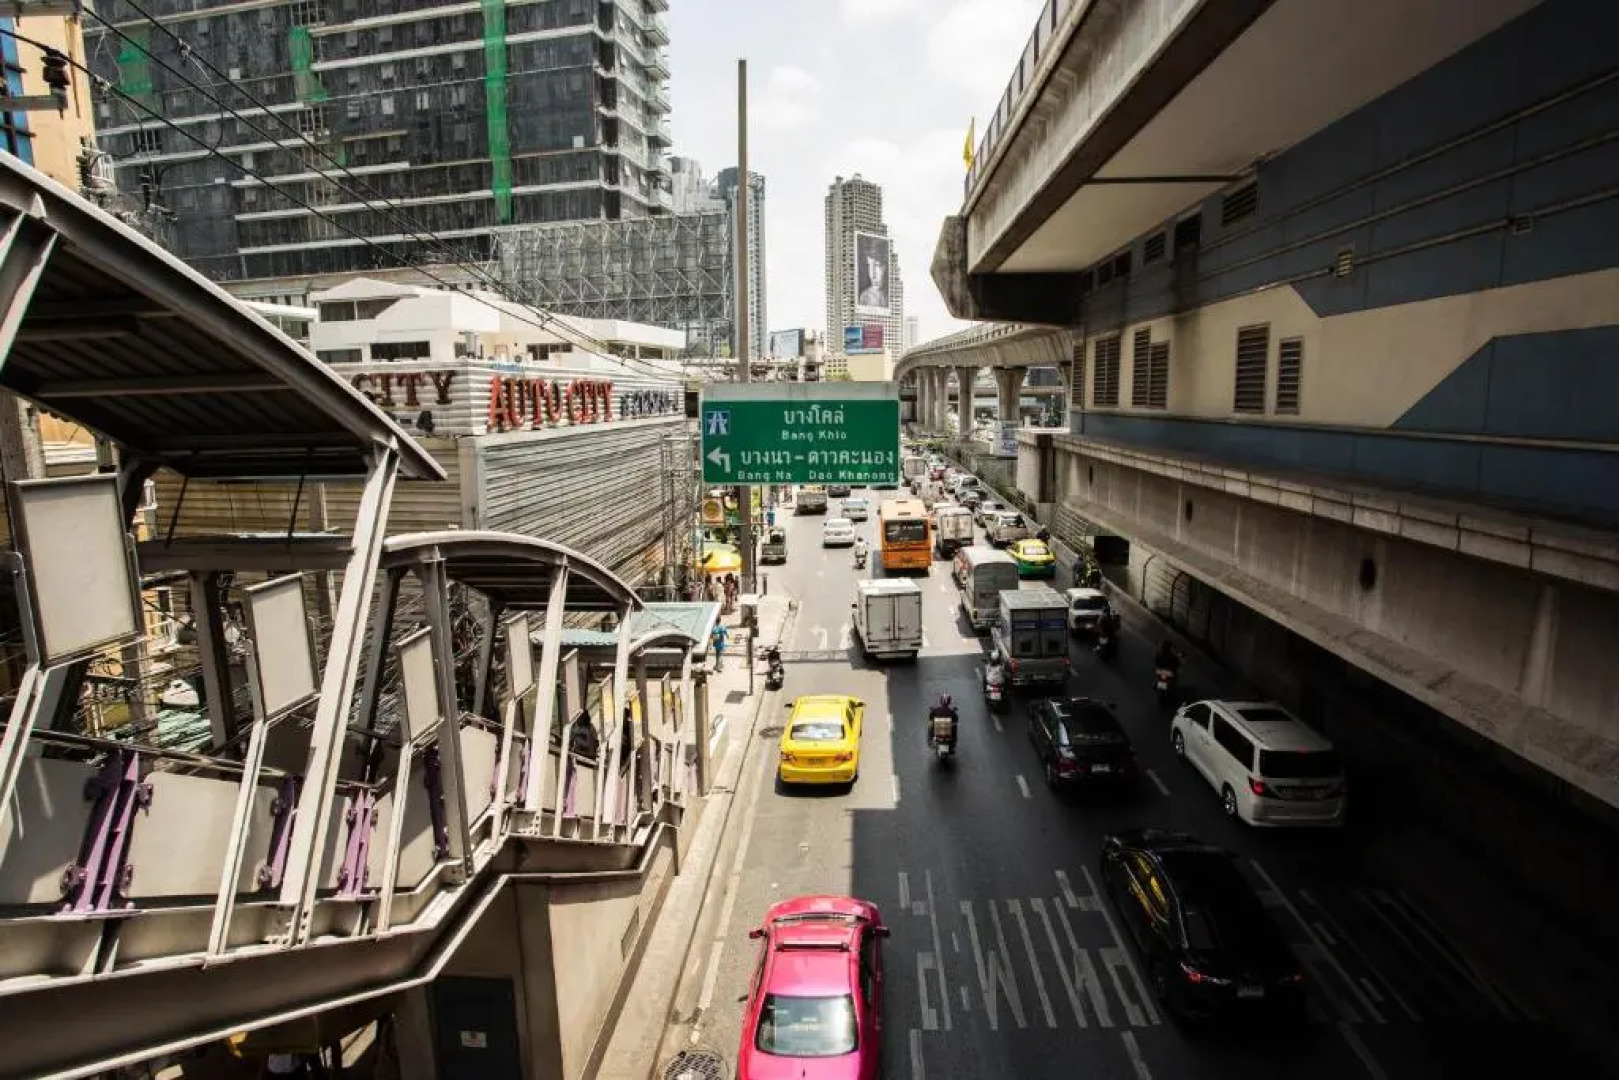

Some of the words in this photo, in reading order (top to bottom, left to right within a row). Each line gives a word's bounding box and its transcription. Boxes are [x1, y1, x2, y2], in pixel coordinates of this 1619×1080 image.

[351, 370, 458, 406] CITY
[487, 373, 562, 433] AUTO
[566, 378, 614, 425] CITY
[784, 404, 845, 425] บางโคล่
[781, 430, 814, 443] Bang
[740, 450, 792, 466] บางนา
[737, 470, 771, 482] Bang
[775, 470, 792, 481] Na
[808, 470, 833, 481] Dao
[839, 470, 895, 482] Khanong
